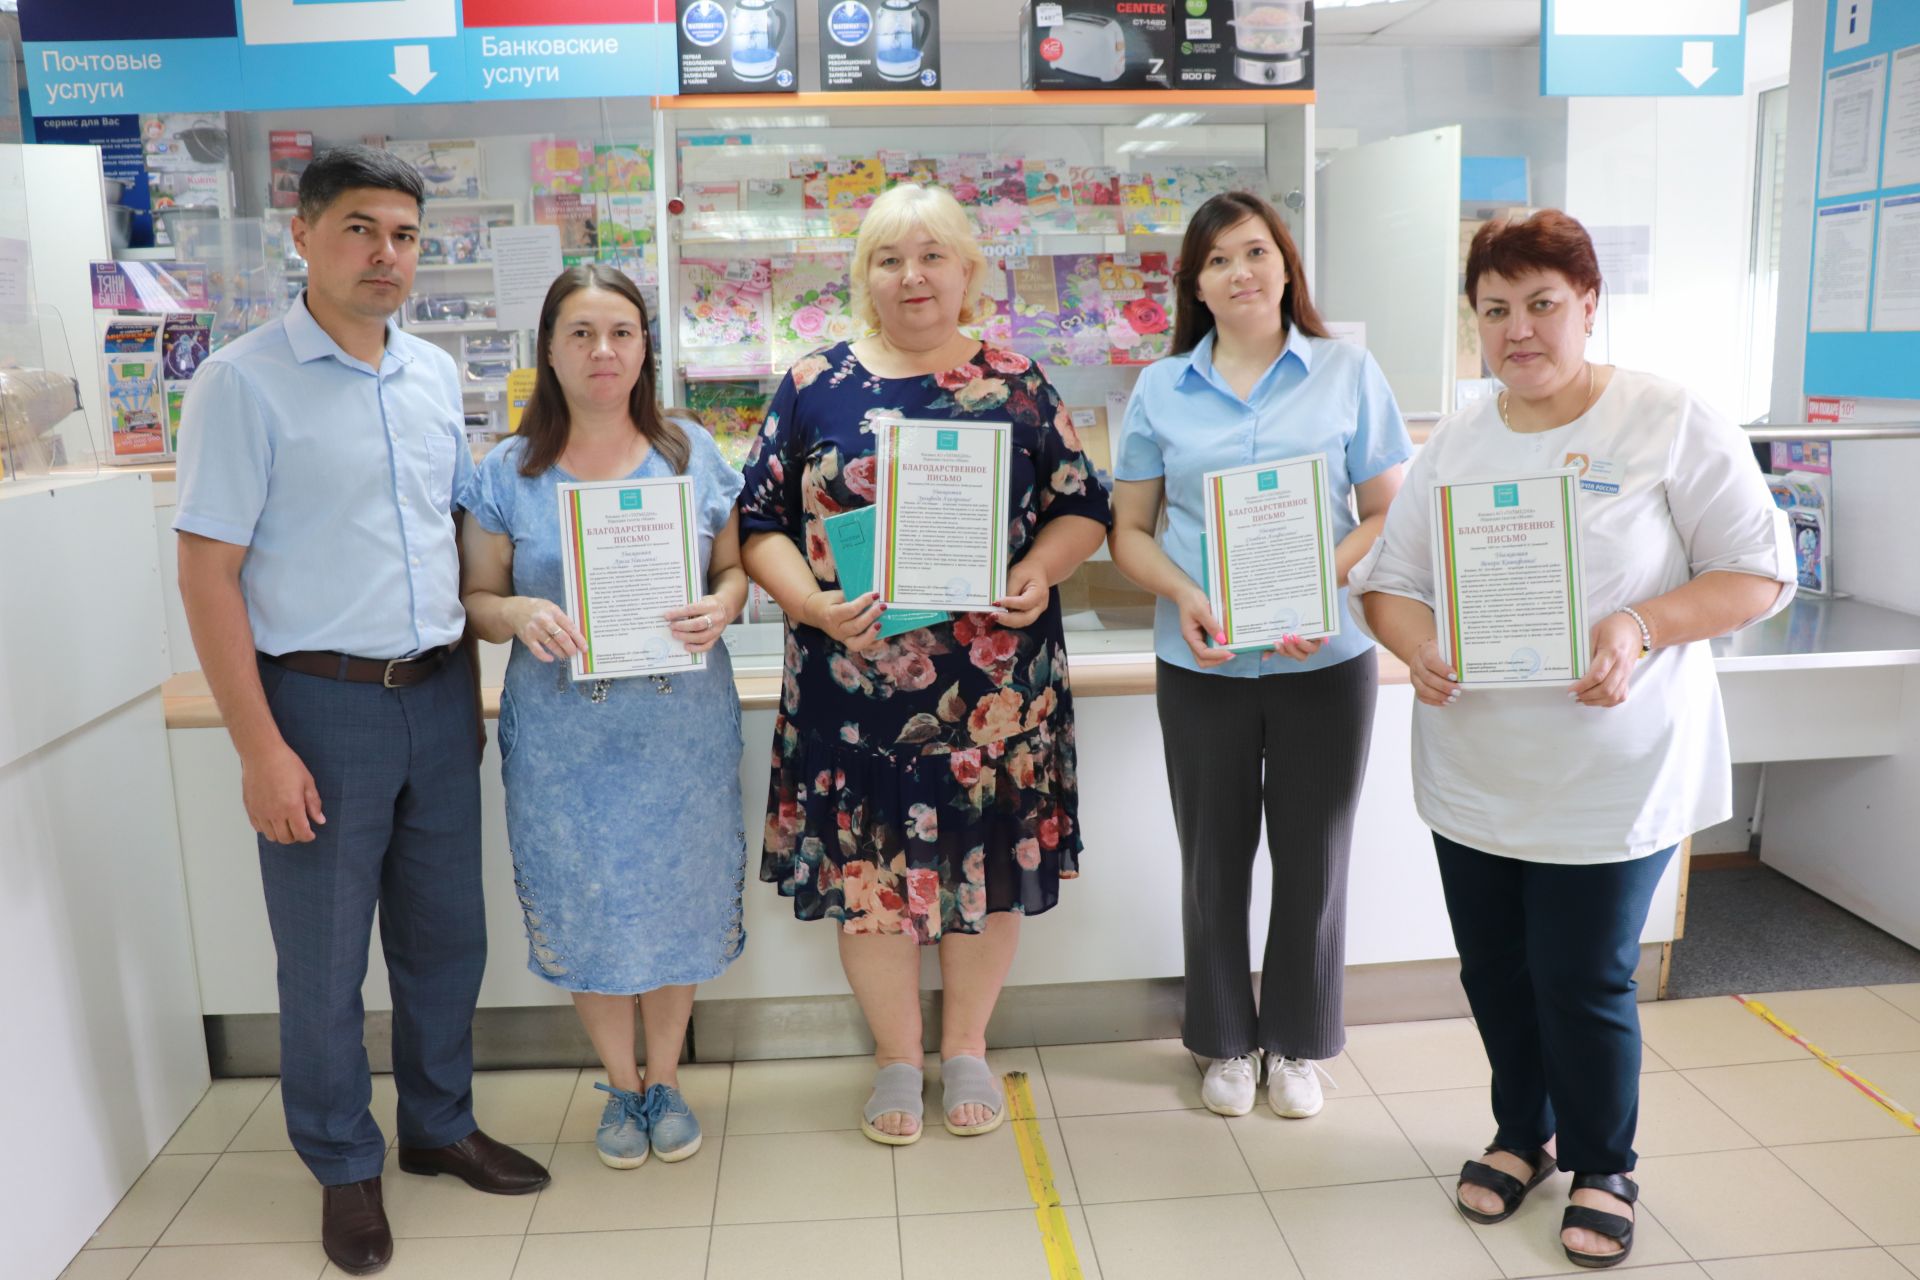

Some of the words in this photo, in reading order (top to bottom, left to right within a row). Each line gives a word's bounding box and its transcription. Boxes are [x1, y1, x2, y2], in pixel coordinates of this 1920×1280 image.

[1116, 3, 1167, 14] CENTEK
[482, 36, 619, 57] Банковские
[42, 50, 162, 72] Почтовые
[1148, 58, 1164, 74] 7
[482, 66, 560, 89] услуги
[1181, 72, 1203, 80] 800
[1203, 72, 1217, 80] Вт
[45, 81, 124, 104] услуги
[44, 118, 79, 129] сервис
[80, 118, 100, 127] для
[102, 117, 120, 126] Вас
[97, 275, 126, 294] ТЯНИ
[1841, 402, 1856, 417] 101
[902, 463, 987, 473] БЛАГОДАРСТВЕННОЕ
[927, 474, 962, 482] ПИСЬМО
[1228, 498, 1308, 517] БЛАГОДАРСТВЕННОЕ
[1252, 512, 1286, 522] ПИСЬМО
[587, 522, 675, 536] БЛАГОДАРСТВЕННОЕ
[1458, 520, 1556, 535] БЛАГОДАРСТВЕННОЕ
[613, 535, 650, 544] ПИСЬМО
[1487, 534, 1527, 544] ПИСЬМО
